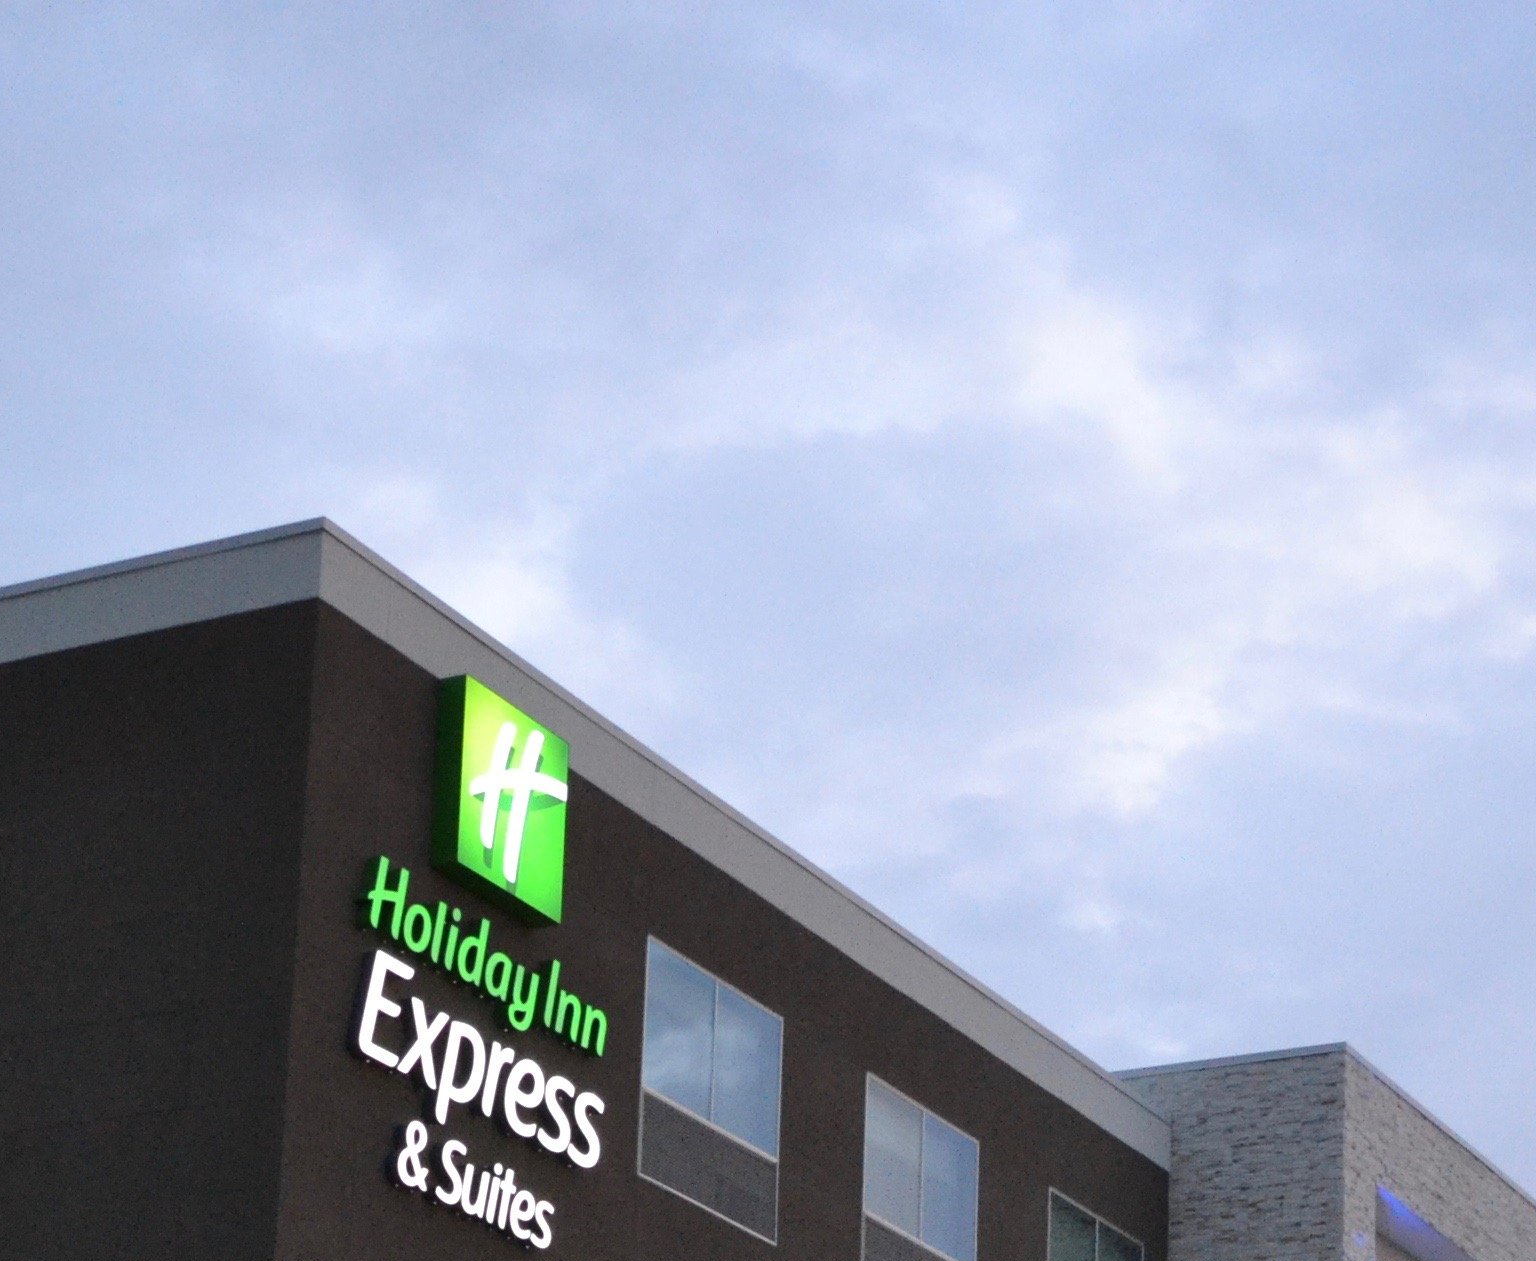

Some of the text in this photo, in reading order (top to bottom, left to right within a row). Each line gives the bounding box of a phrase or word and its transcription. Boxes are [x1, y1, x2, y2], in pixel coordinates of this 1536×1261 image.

[367, 855, 607, 1057] Holiday Inn
[358, 950, 605, 1168] Express
[397, 1120, 555, 1249] & Suites
